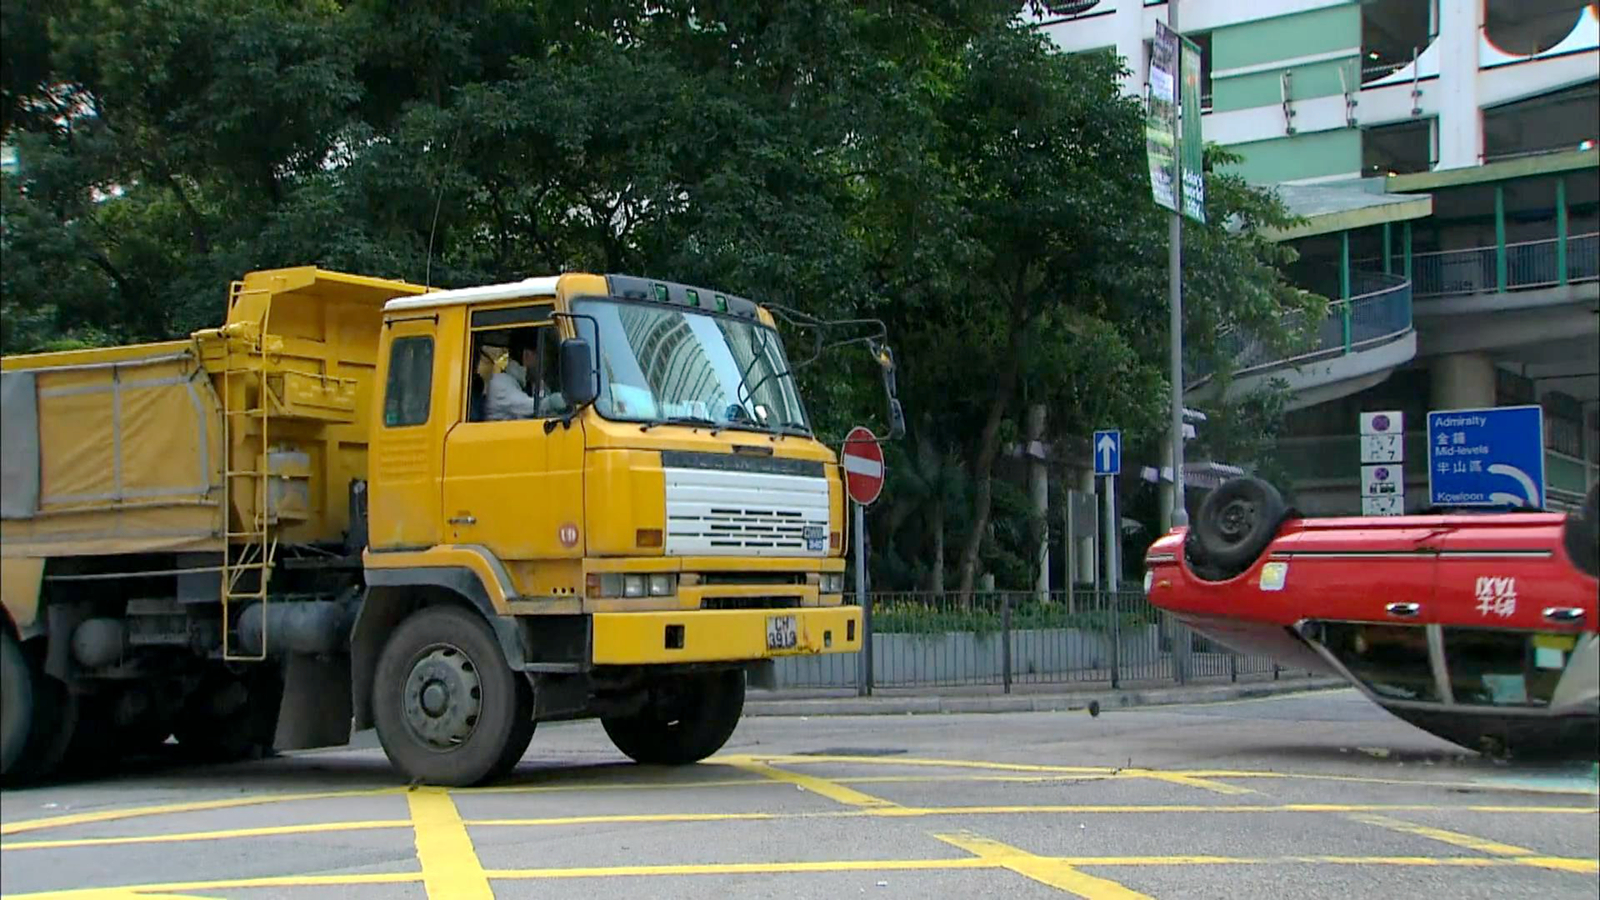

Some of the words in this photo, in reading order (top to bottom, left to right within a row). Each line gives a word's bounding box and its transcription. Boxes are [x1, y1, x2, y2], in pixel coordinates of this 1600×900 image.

[1435, 416, 1487, 428] Admiralty
[1437, 432, 1466, 445] 金鐘
[1435, 445, 1489, 457] Mid-levels
[1437, 460, 1483, 475] 半山區
[1437, 491, 1484, 502] Kowloon
[1475, 576, 1517, 597] TAXI
[1475, 596, 1516, 617] 的士
